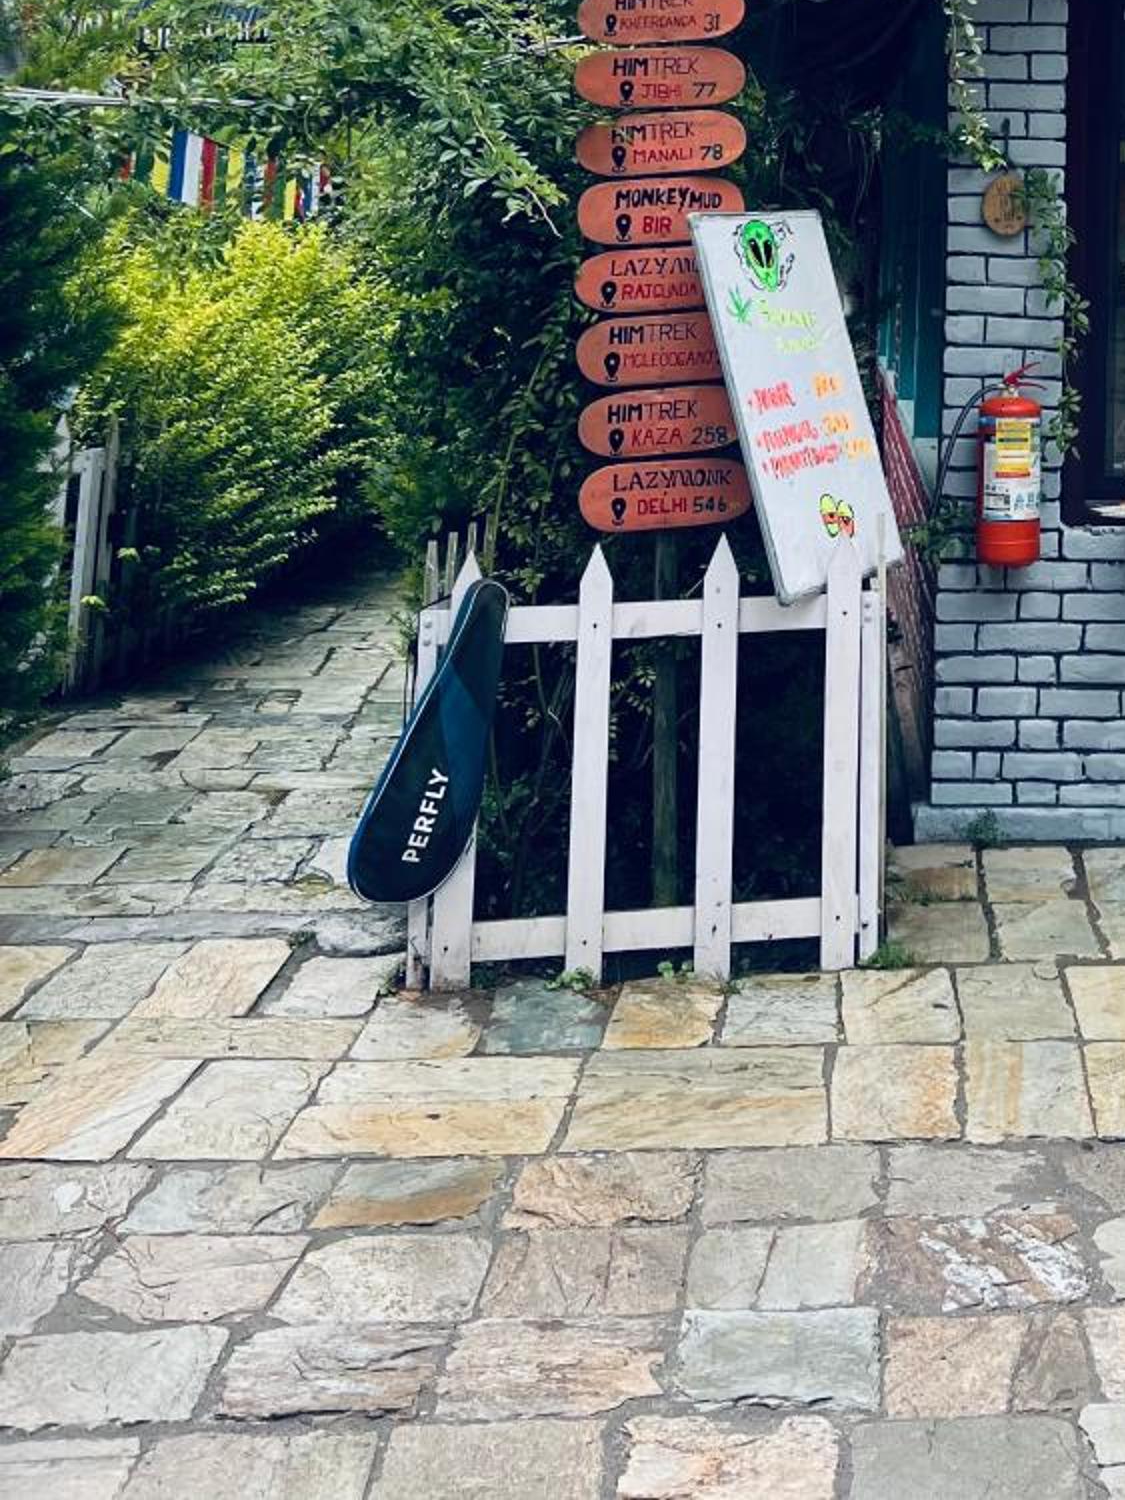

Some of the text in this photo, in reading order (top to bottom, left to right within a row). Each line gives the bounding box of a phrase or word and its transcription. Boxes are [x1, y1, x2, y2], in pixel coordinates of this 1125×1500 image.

[703, 13, 721, 33] 31
[641, 82, 717, 99] JIBHI 77
[633, 143, 723, 164] MANALI 78
[614, 186, 723, 212] MONKEYMUD
[642, 216, 673, 235] BIR
[631, 425, 728, 447] KAZA 258
[637, 496, 727, 516] DELHI 546
[401, 767, 449, 865] PERFLY
